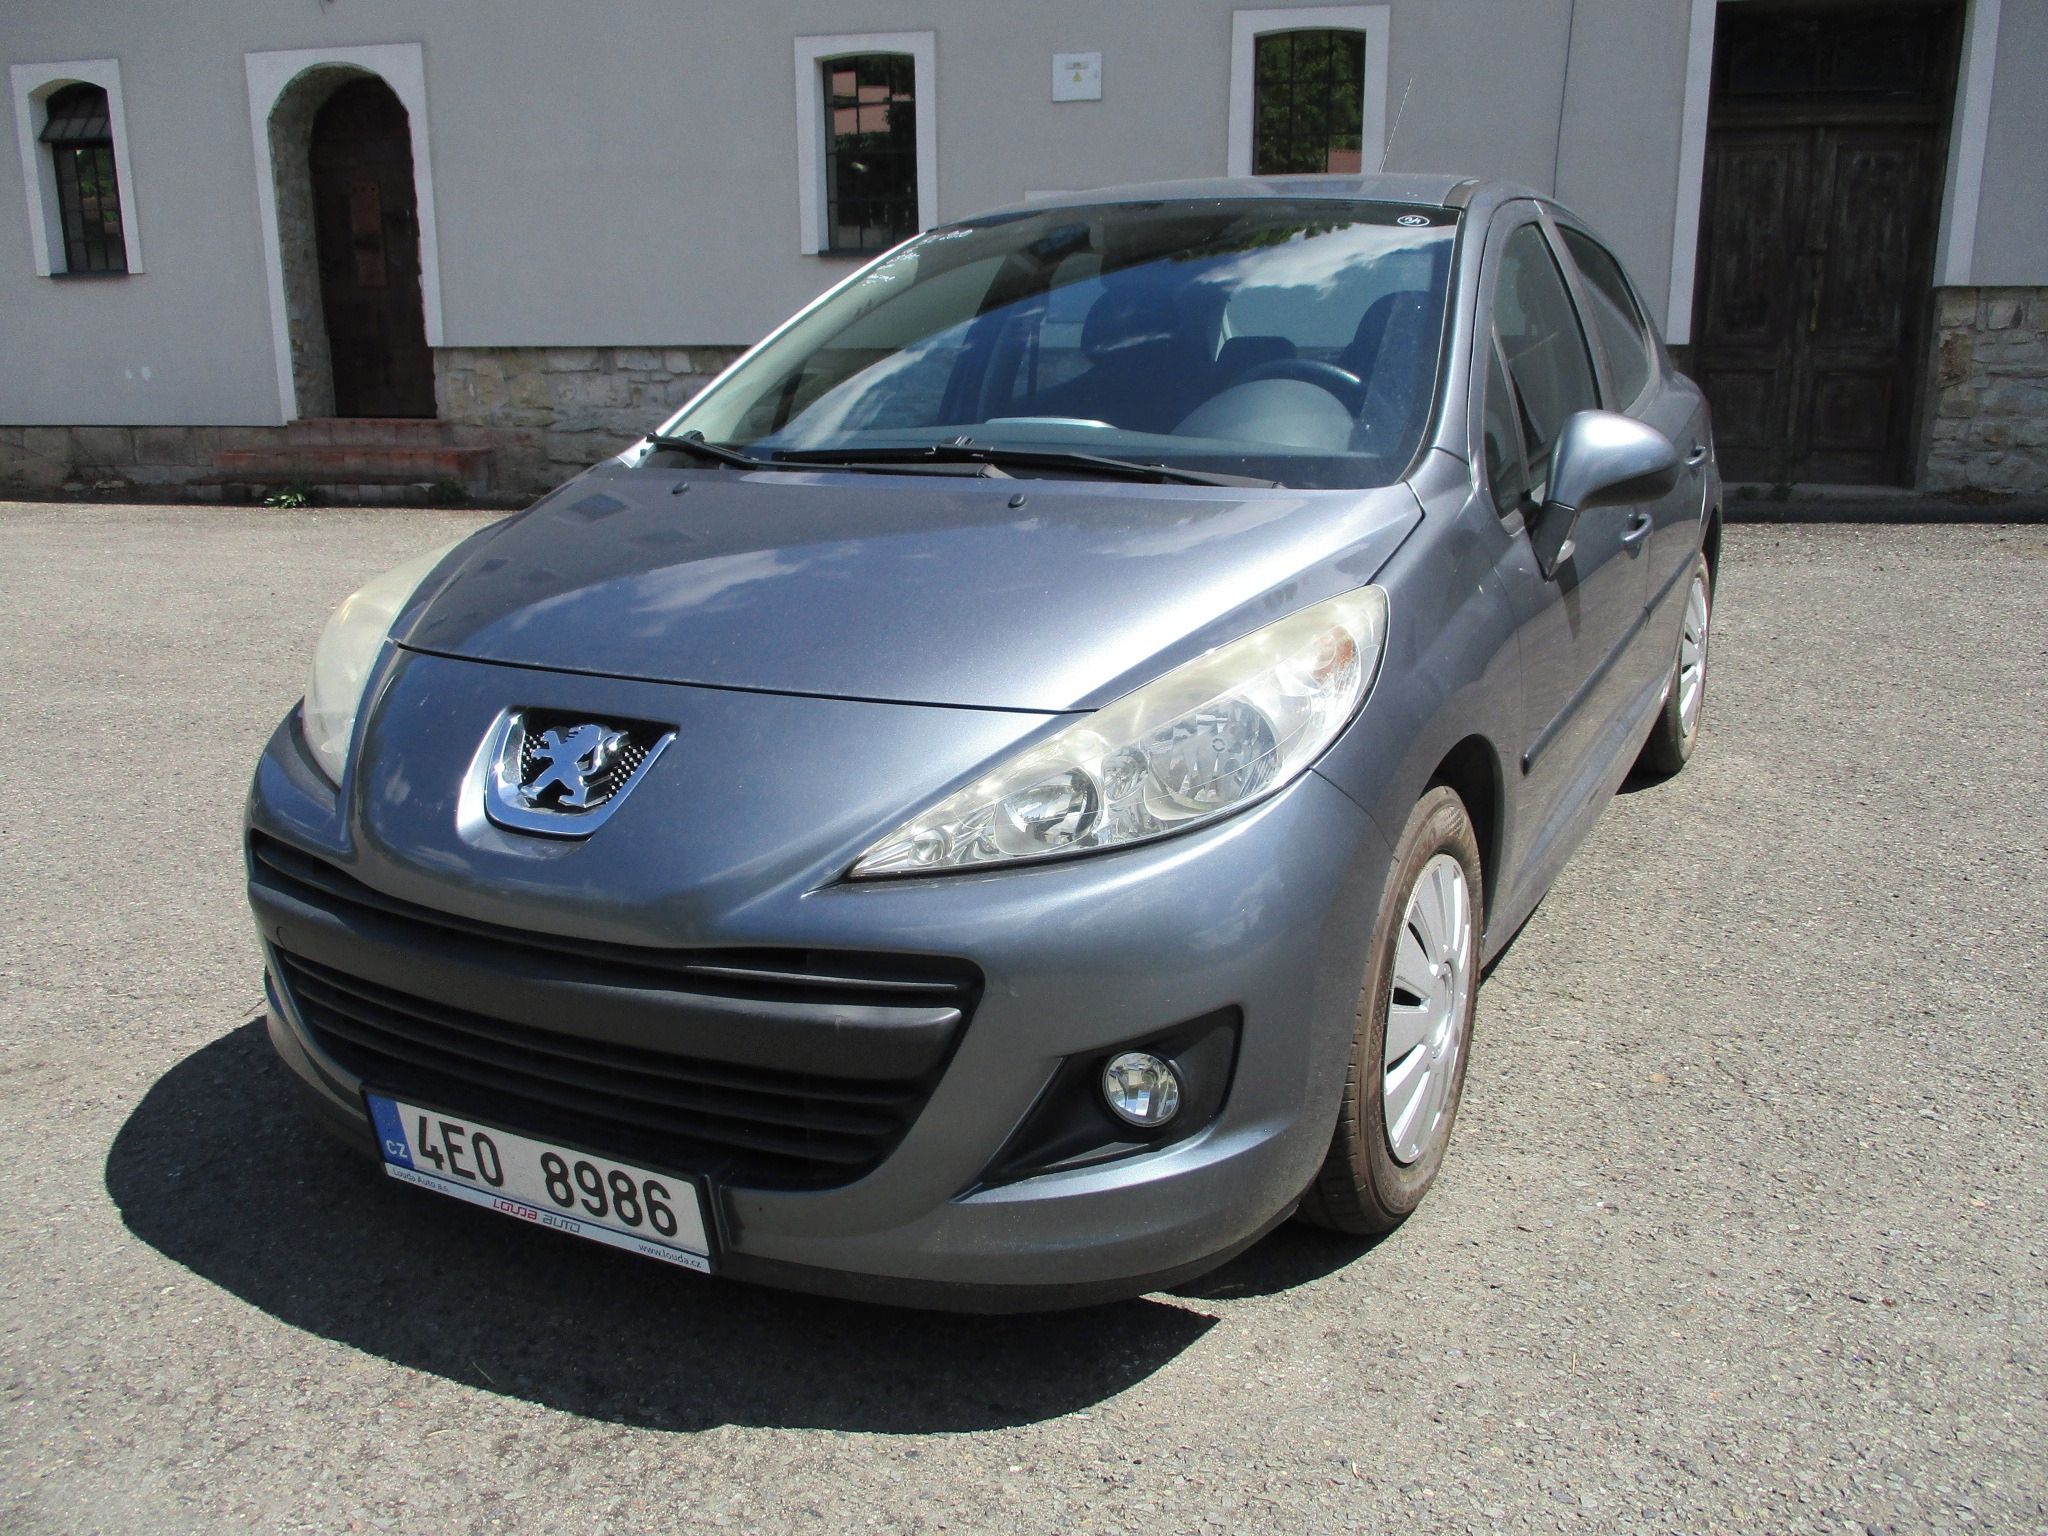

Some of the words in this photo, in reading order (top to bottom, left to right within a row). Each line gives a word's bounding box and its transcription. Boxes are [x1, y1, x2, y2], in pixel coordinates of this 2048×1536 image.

[386, 1139, 408, 1158] CZ
[418, 1115, 504, 1187] 4E0
[540, 1151, 678, 1237] 8986
[638, 1244, 702, 1268] www.louda.cz
